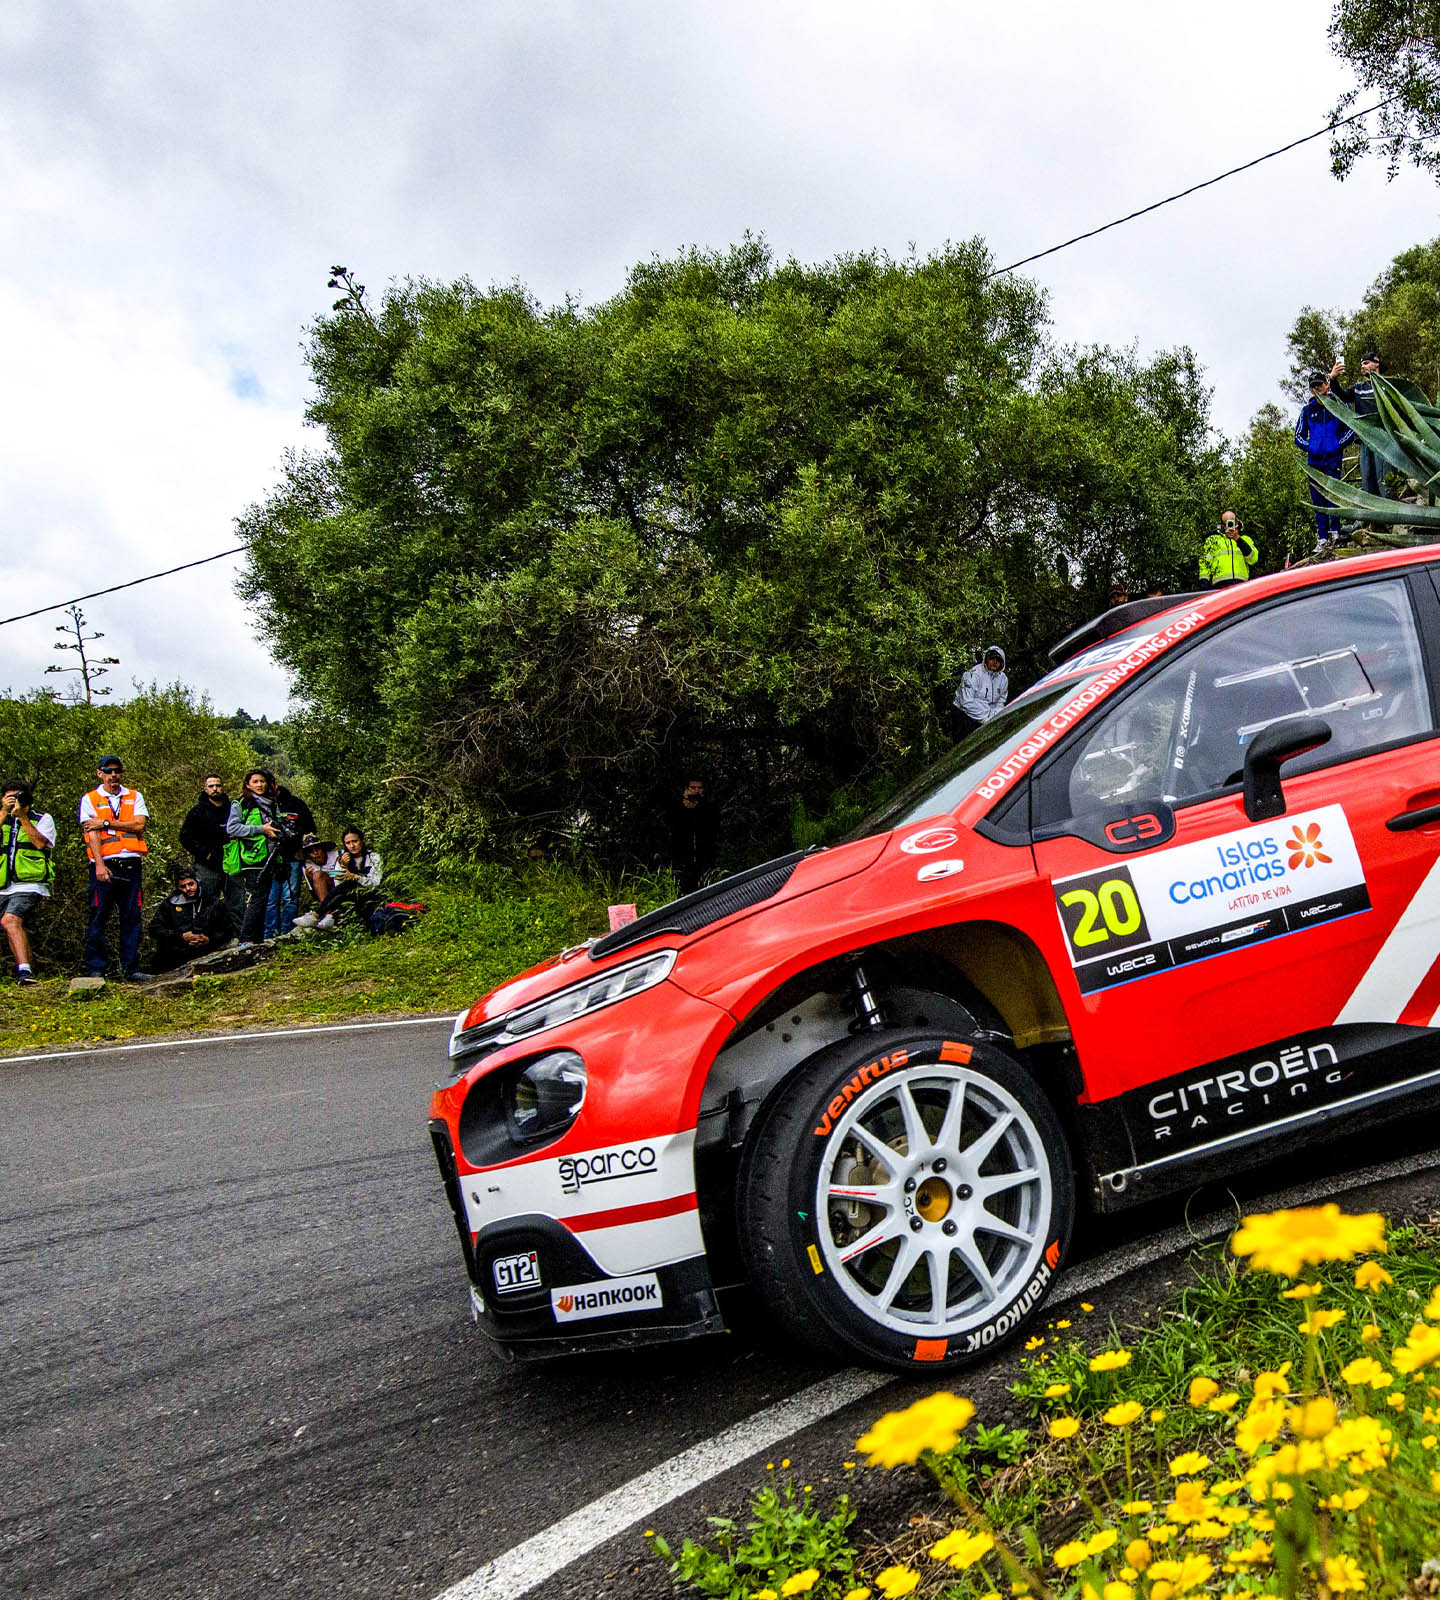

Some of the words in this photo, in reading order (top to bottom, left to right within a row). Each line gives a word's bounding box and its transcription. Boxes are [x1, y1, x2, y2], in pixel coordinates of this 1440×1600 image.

[976, 611, 1205, 799] BOUTIQUE.CITROENRACING.COM
[1104, 813, 1162, 845] C3
[1217, 837, 1279, 868] Islas
[1169, 858, 1286, 904] Canarias
[1228, 894, 1260, 911] LATITUD
[1262, 890, 1273, 901] DE
[1273, 885, 1292, 897] VIDA
[1060, 878, 1142, 948] 20
[1107, 954, 1156, 976] WRC2
[1148, 1042, 1339, 1120] CITROËN
[1153, 1070, 1342, 1140] RACING
[559, 1146, 657, 1188] sparco
[495, 1252, 538, 1286] GT2i
